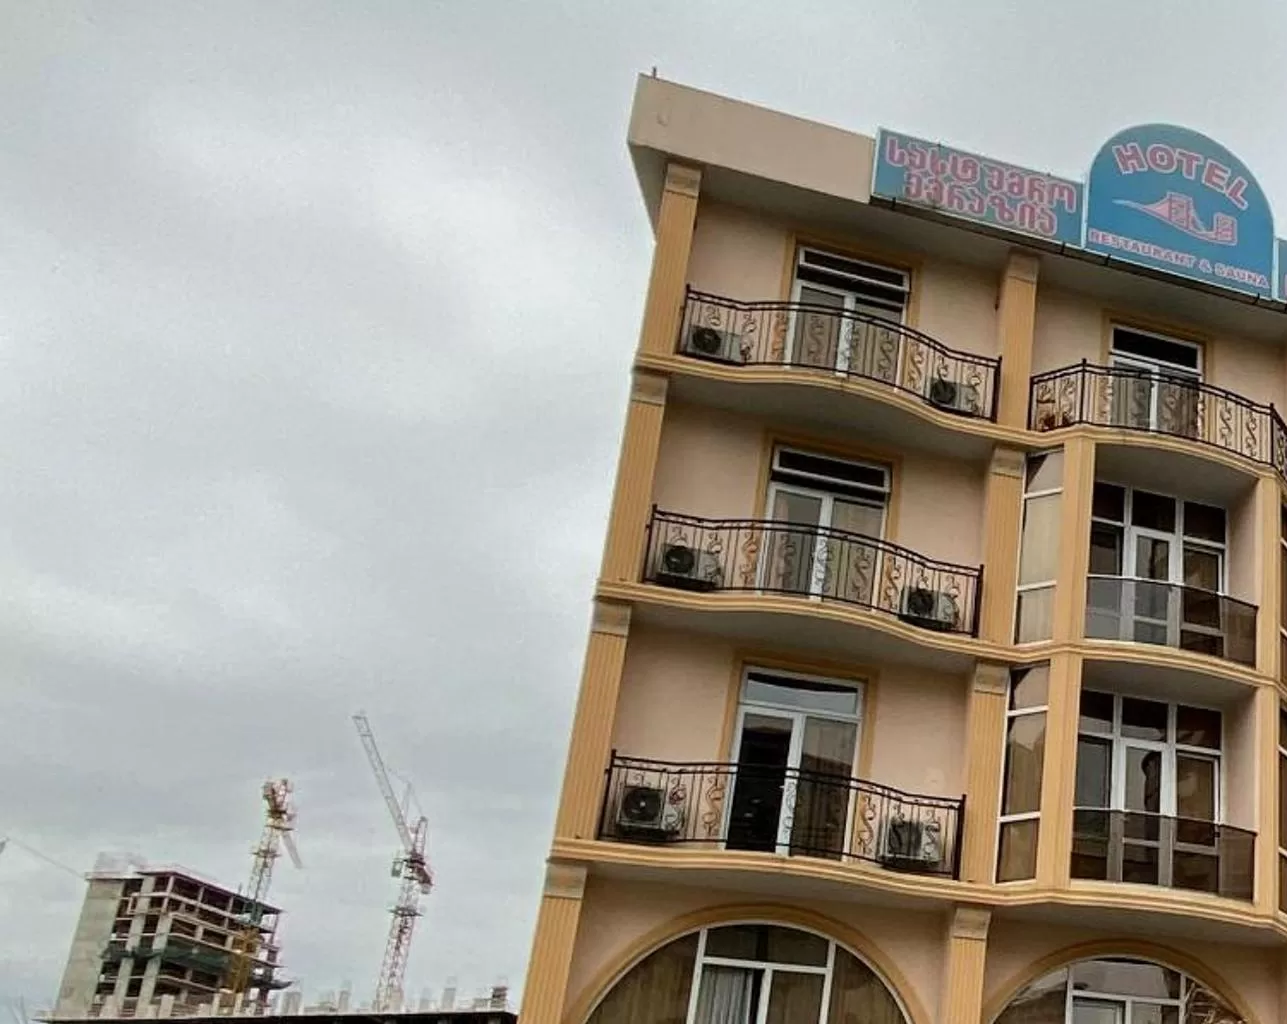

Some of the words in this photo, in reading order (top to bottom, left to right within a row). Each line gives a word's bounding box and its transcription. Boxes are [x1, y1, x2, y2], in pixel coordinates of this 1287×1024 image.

[1112, 142, 1249, 211] HOTEL
[1088, 228, 1196, 269] RESTAURANT
[1214, 262, 1270, 289] SAUNA
